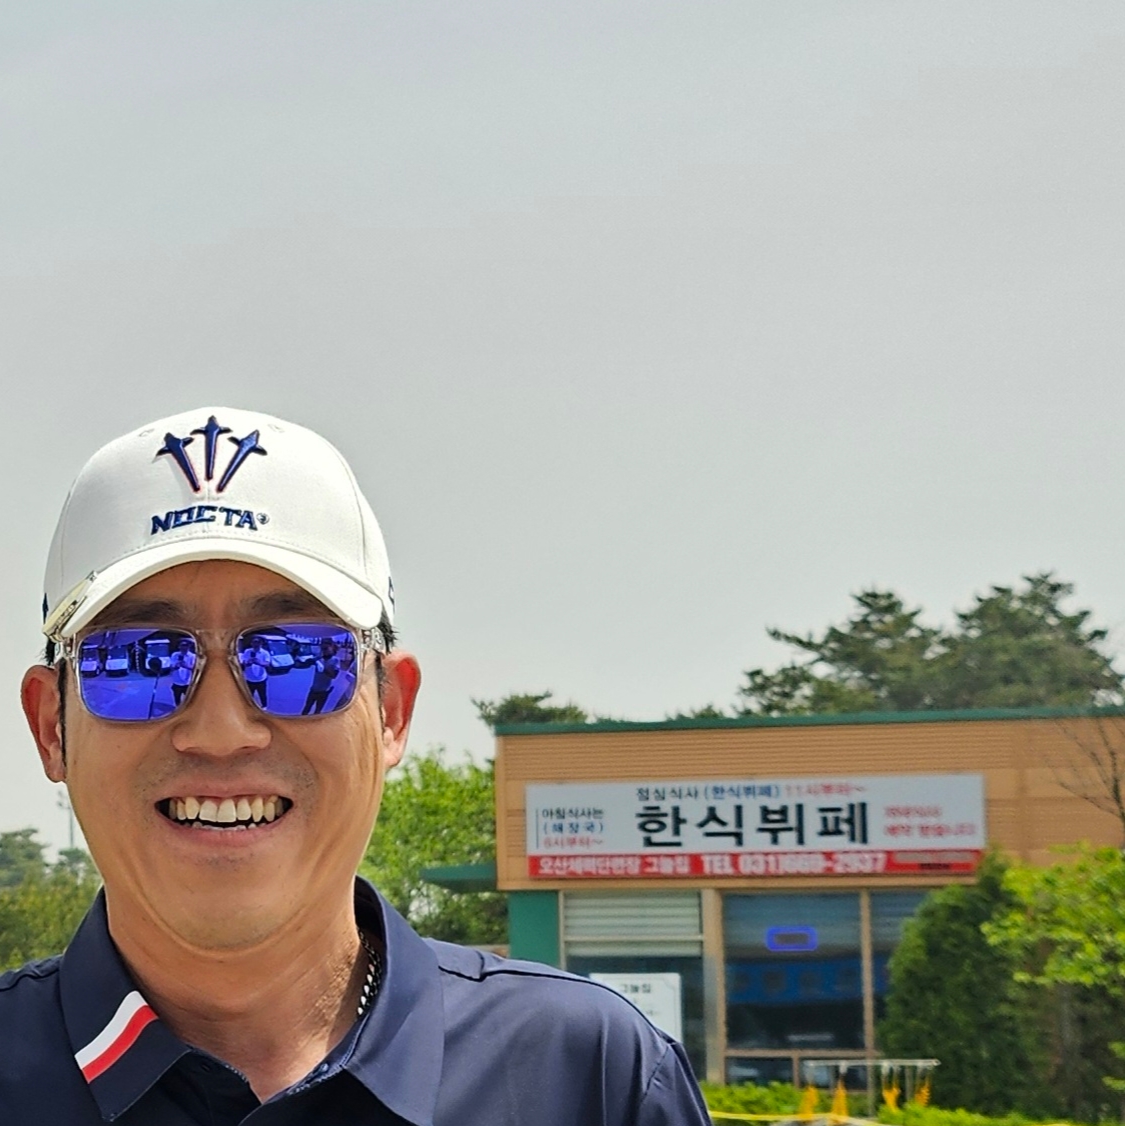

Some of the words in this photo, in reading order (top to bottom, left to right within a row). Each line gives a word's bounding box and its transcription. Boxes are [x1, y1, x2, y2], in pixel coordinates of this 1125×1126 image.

[636, 786, 698, 801] 점심식사
[704, 783, 780, 800] (한식뷔페)
[635, 801, 869, 848] 한식뷔페
[701, 853, 735, 875] TEL
